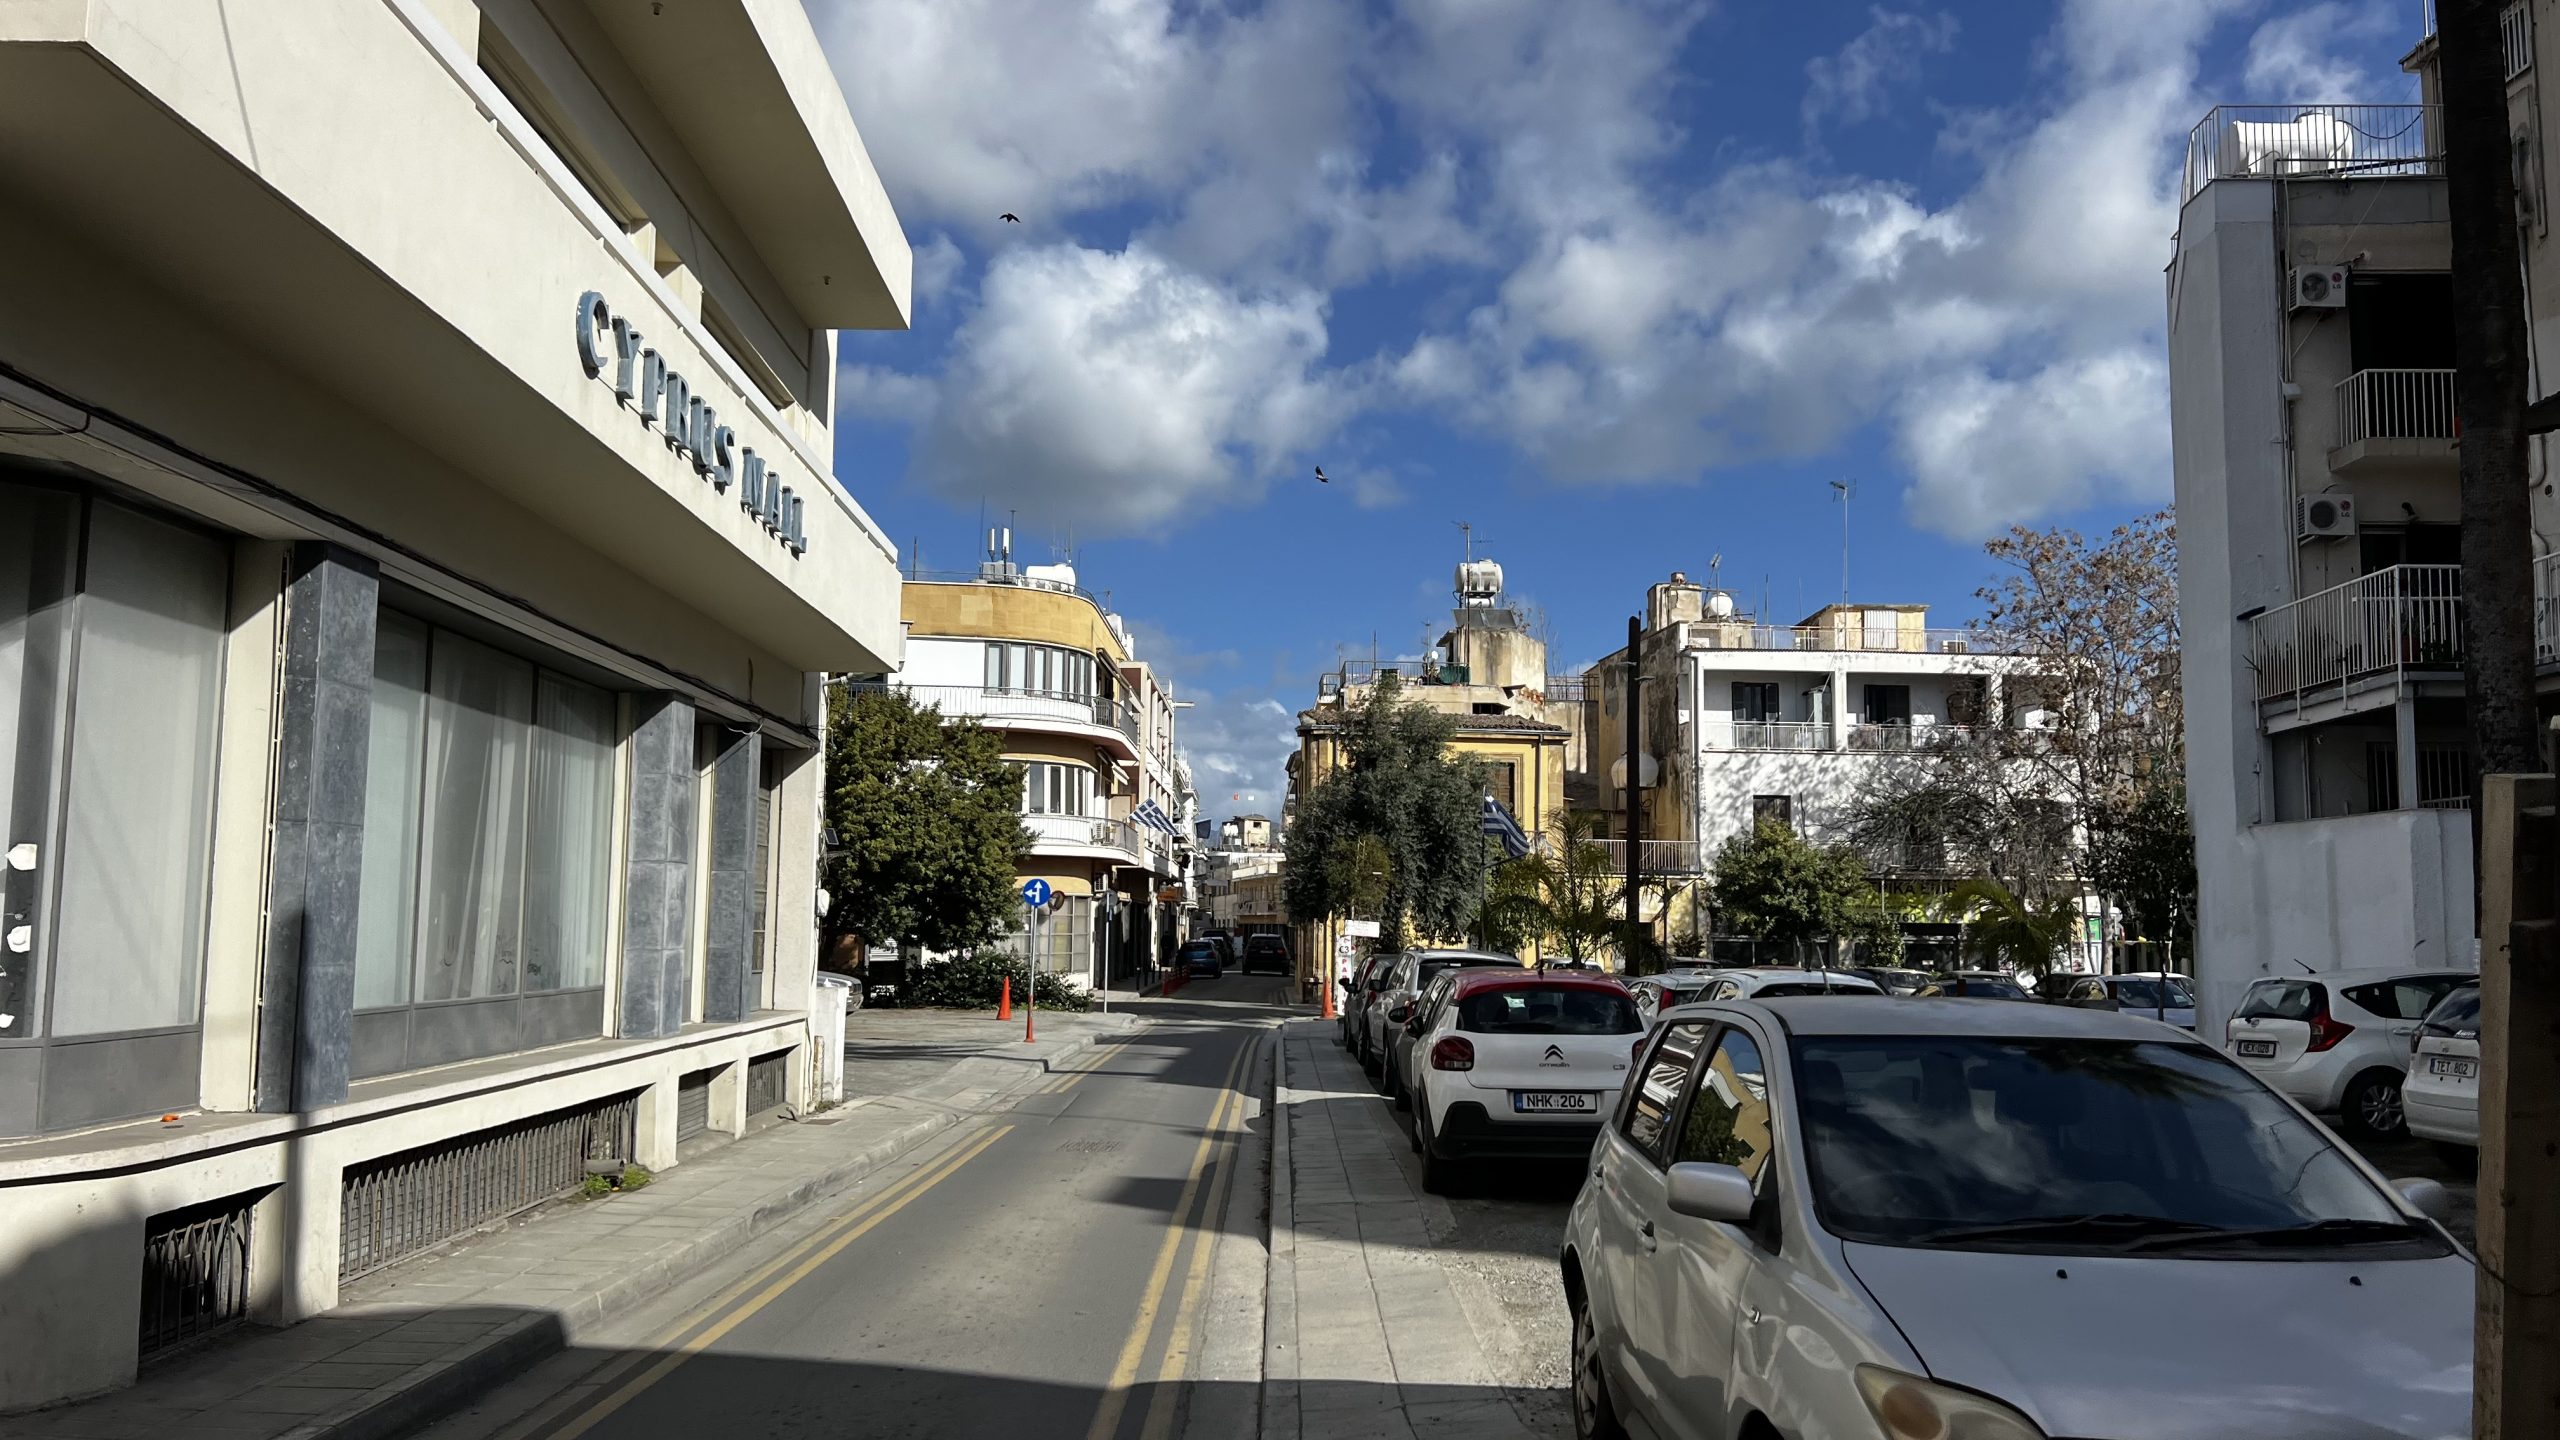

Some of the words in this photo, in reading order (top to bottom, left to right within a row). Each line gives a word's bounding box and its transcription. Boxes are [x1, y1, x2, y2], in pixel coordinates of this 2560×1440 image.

[576, 291, 735, 486] CYPRUS
[741, 447, 807, 554] MAIL
[2437, 1060, 2451, 1073] TET
[1526, 1095, 1555, 1108] NHK
[1560, 1095, 1585, 1108] 206
